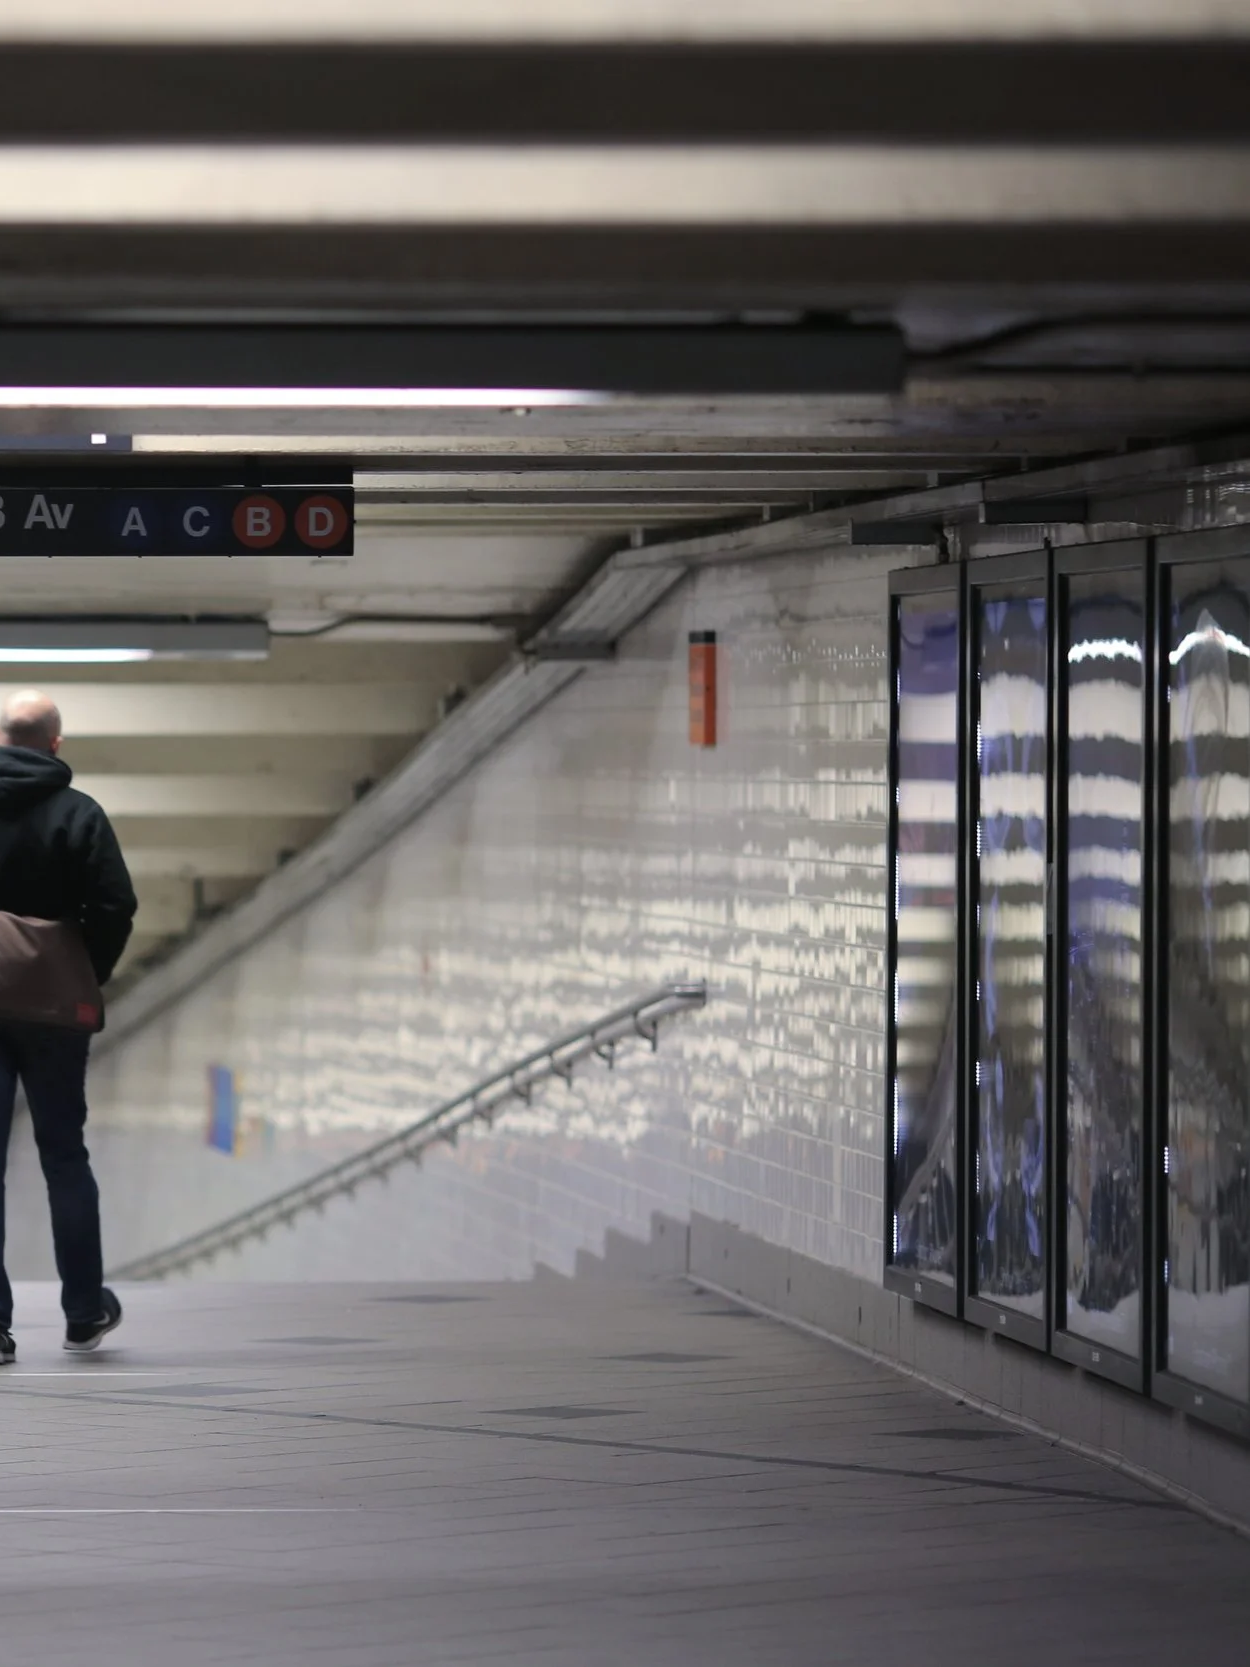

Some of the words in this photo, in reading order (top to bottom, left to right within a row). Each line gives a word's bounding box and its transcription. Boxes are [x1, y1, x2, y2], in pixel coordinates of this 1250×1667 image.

[23, 494, 74, 530] Av
[121, 506, 147, 537] A
[182, 505, 211, 537] C
[246, 506, 272, 537] B
[308, 506, 335, 537] D
